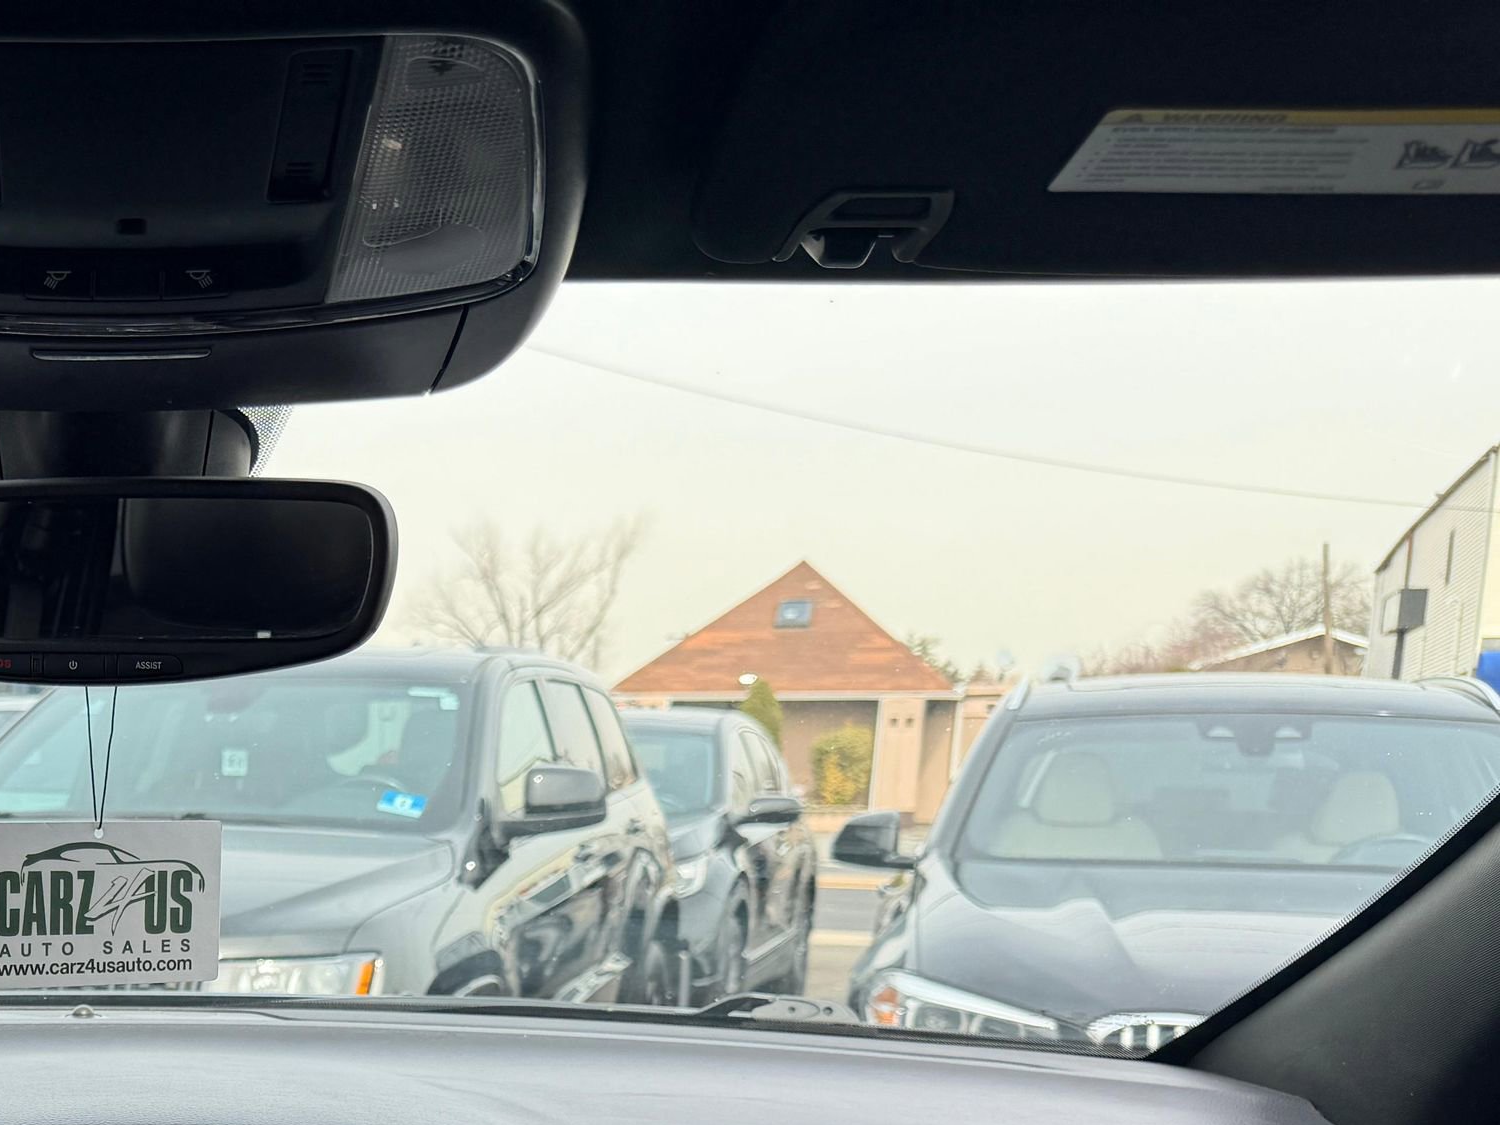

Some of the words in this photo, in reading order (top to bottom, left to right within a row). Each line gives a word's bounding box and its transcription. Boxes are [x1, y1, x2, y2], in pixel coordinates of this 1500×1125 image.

[135, 661, 162, 670] ASSIST
[0, 942, 74, 958] AUTO
[102, 938, 190, 954] SALES
